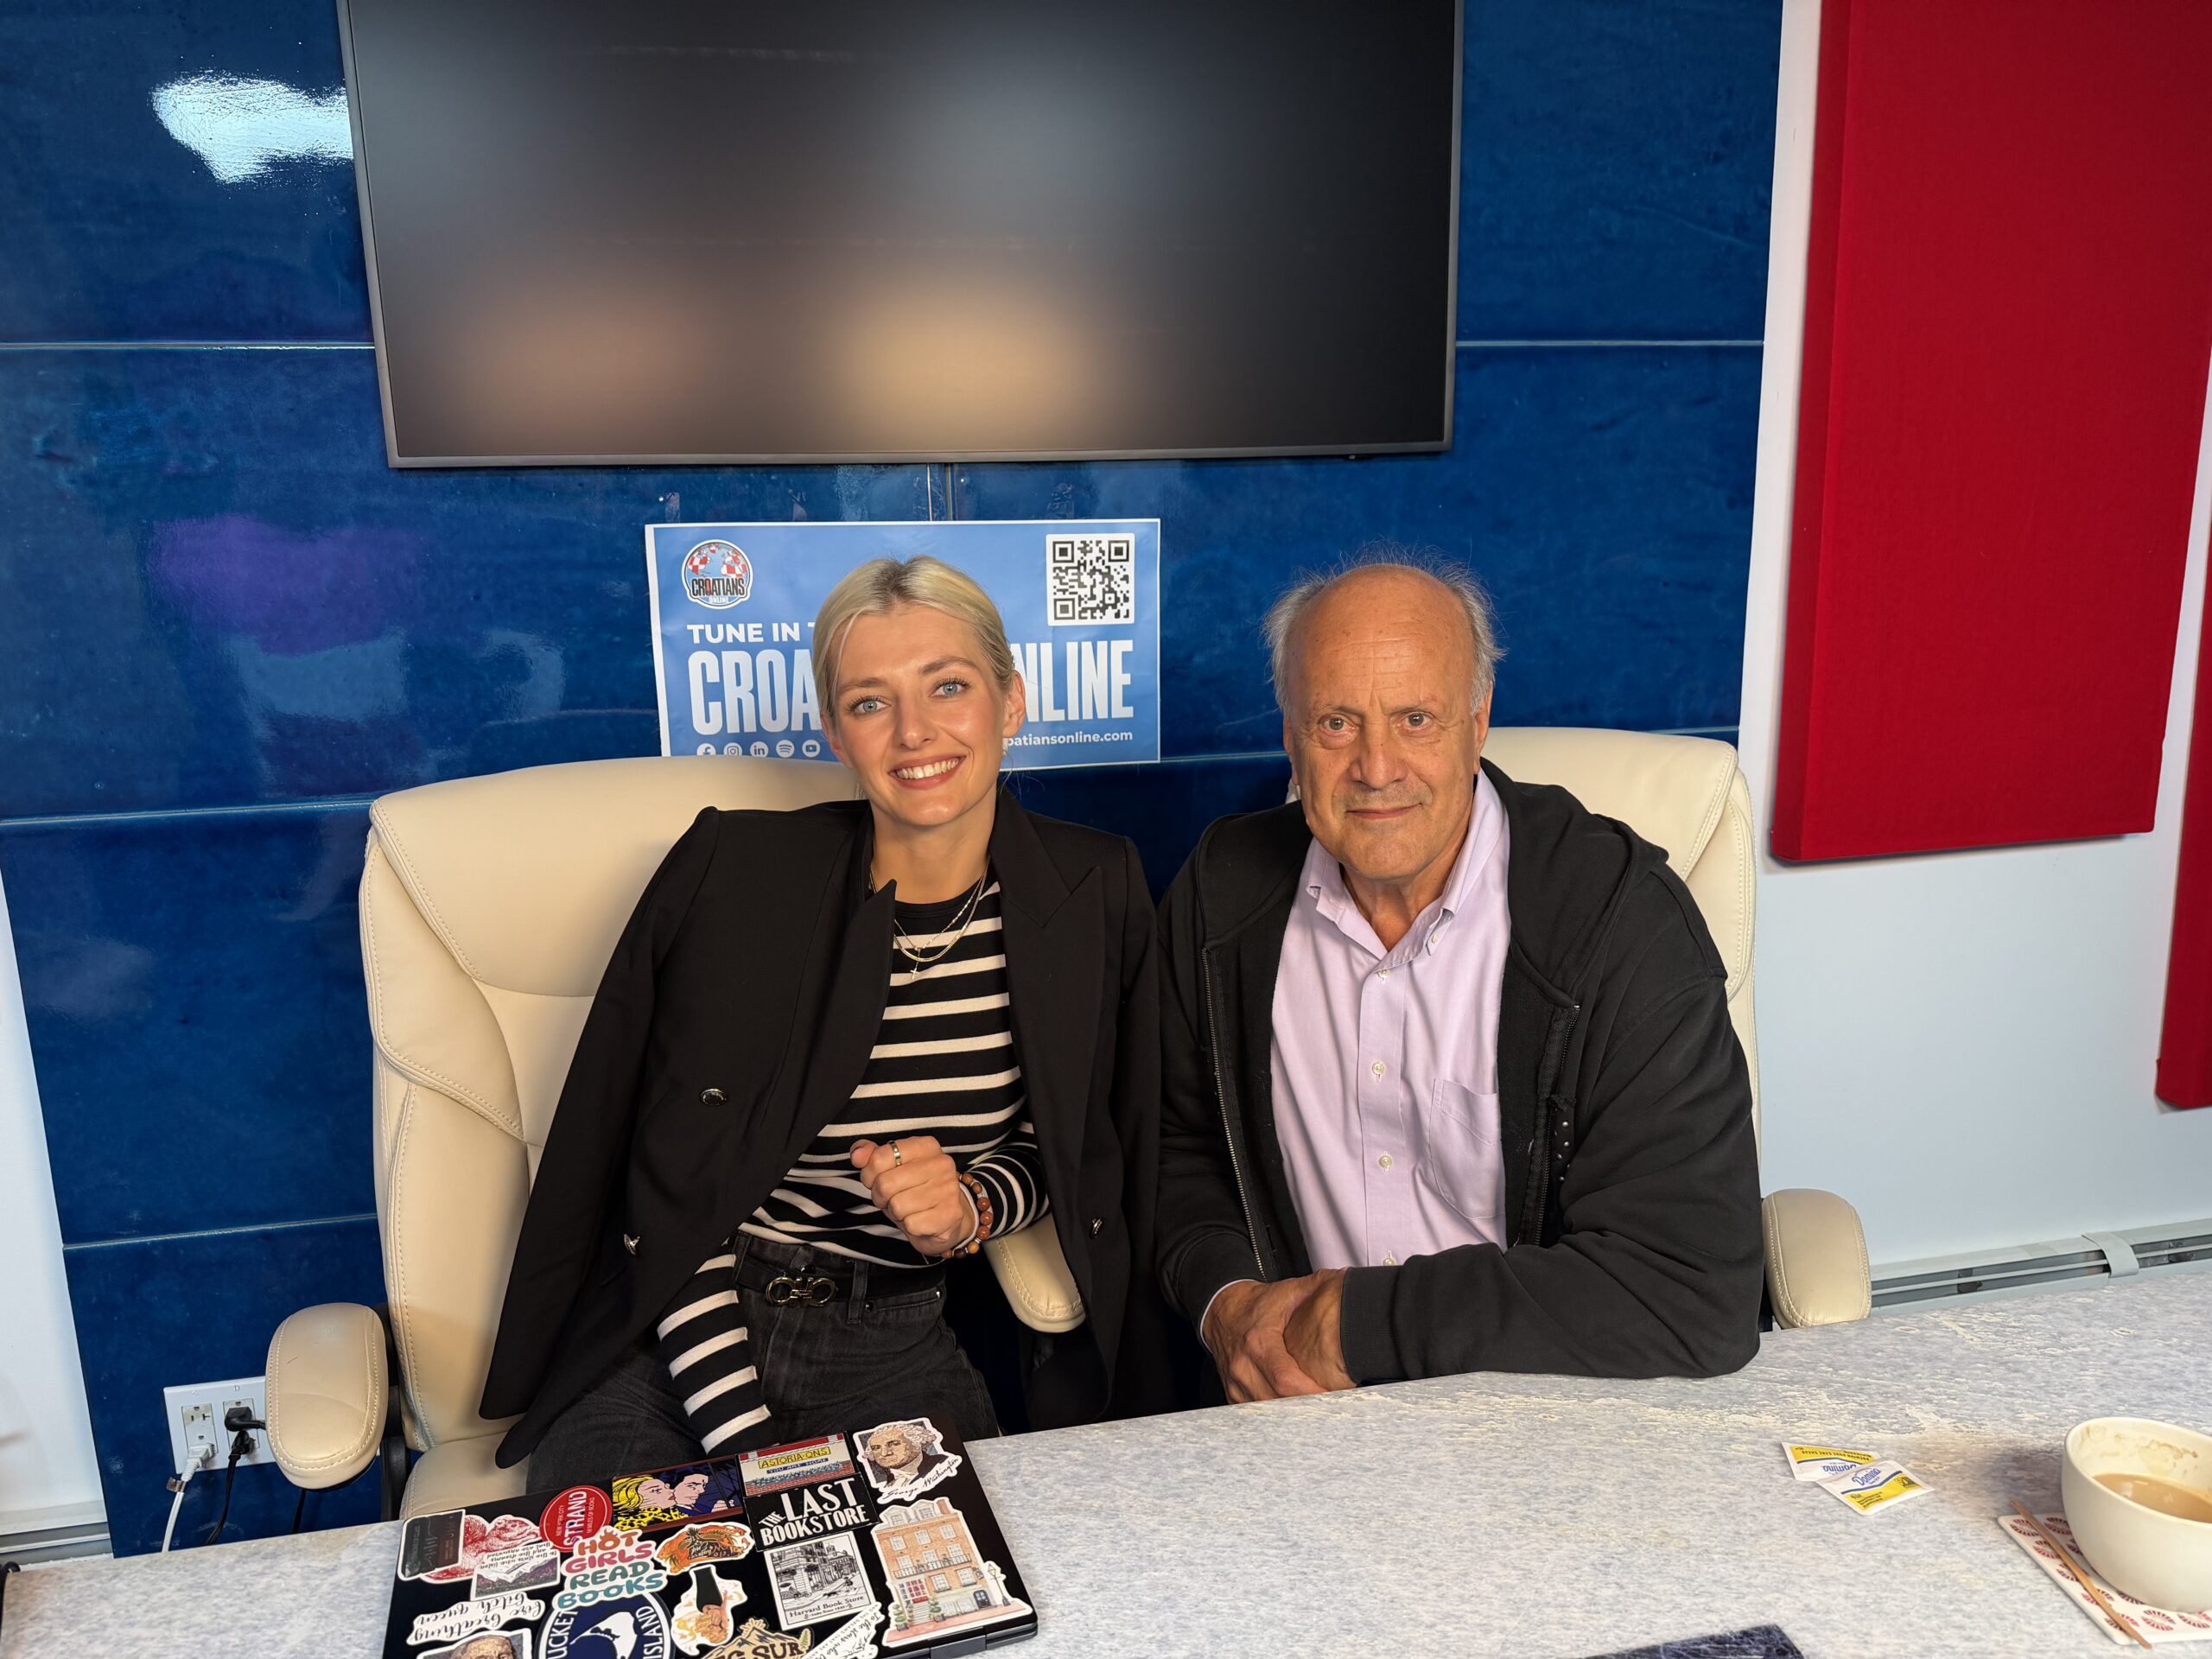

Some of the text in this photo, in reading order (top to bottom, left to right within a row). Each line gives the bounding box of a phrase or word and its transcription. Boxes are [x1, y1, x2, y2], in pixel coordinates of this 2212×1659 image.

[691, 578, 745, 596] CROATIANS
[687, 622, 800, 644] TUNE IN
[688, 639, 1135, 735] CROA NLINE
[563, 1491, 587, 1545] STRAND
[759, 1478, 857, 1529] THE LAST
[760, 1504, 869, 1547] BOOKSTORE
[578, 1529, 638, 1555] HOT
[566, 1544, 652, 1573] GIRLS
[570, 1561, 651, 1590] READ
[558, 1573, 664, 1609] BOOKS
[789, 1605, 821, 1618] Harvard
[823, 1600, 842, 1610] Book
[548, 1606, 663, 1659] UCKET ISLAND
[752, 1643, 804, 1659] SUR
